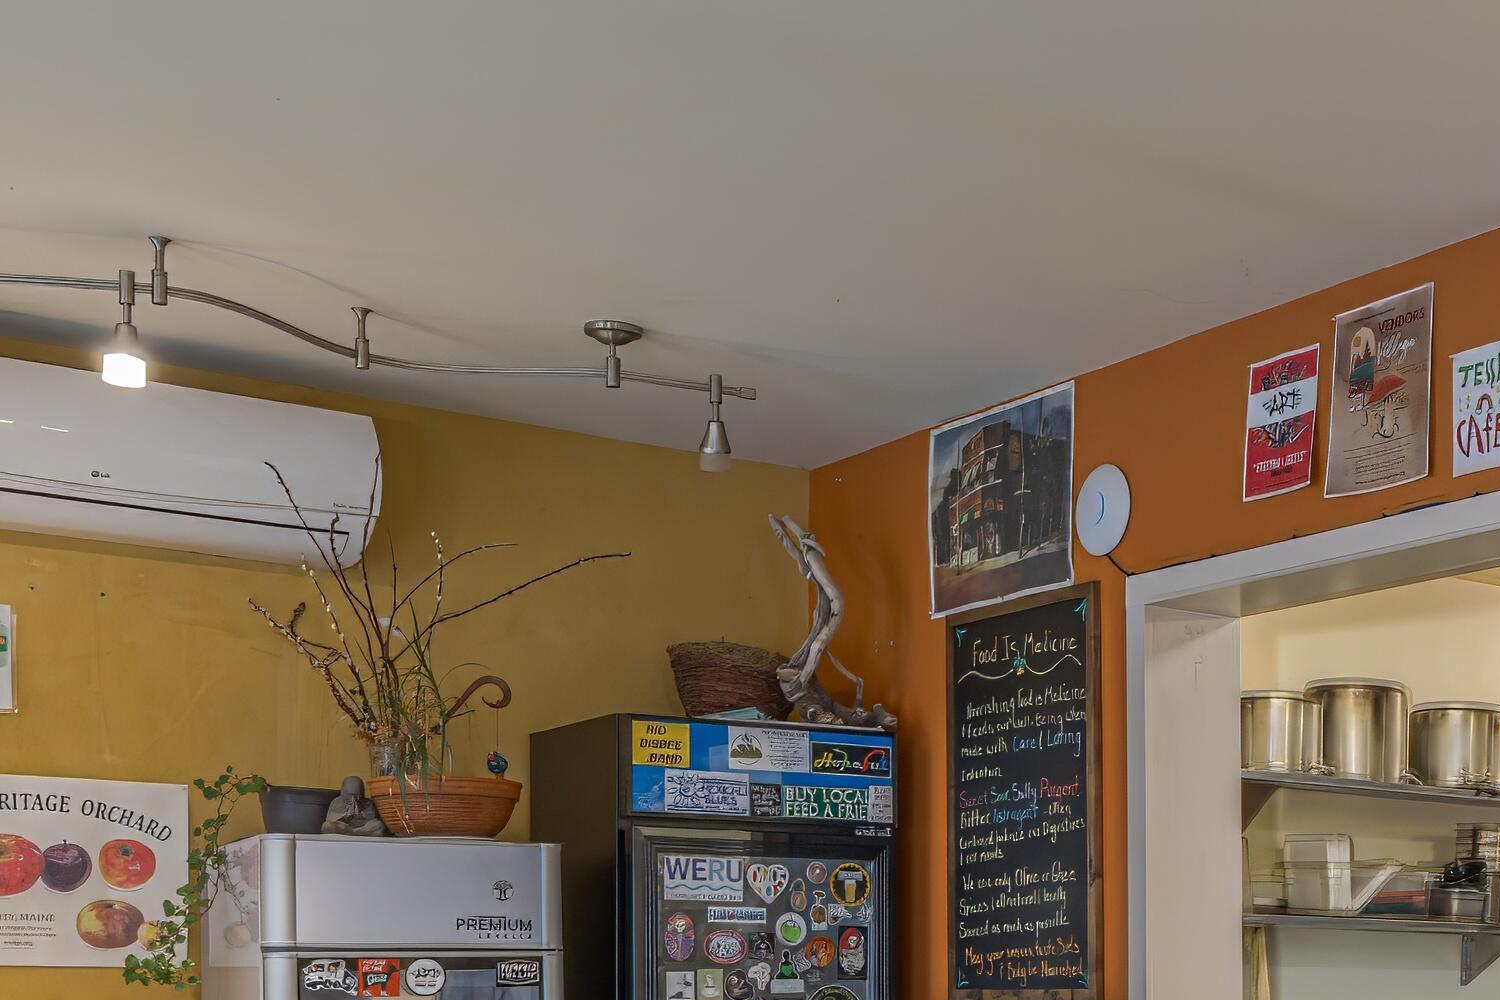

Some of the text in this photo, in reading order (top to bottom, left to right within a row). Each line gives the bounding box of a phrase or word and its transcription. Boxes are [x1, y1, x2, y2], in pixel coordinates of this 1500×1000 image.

[972, 636, 998, 668] Food
[1023, 630, 1078, 656] Medicine
[786, 787, 817, 802] BUY
[787, 802, 819, 817] FEED
[824, 800, 834, 817] A
[839, 804, 868, 819] FRIE
[960, 808, 991, 829] Bitter
[81, 799, 172, 842] ORCHARD
[665, 857, 742, 882] WERU
[456, 918, 532, 931] PREMIUM
